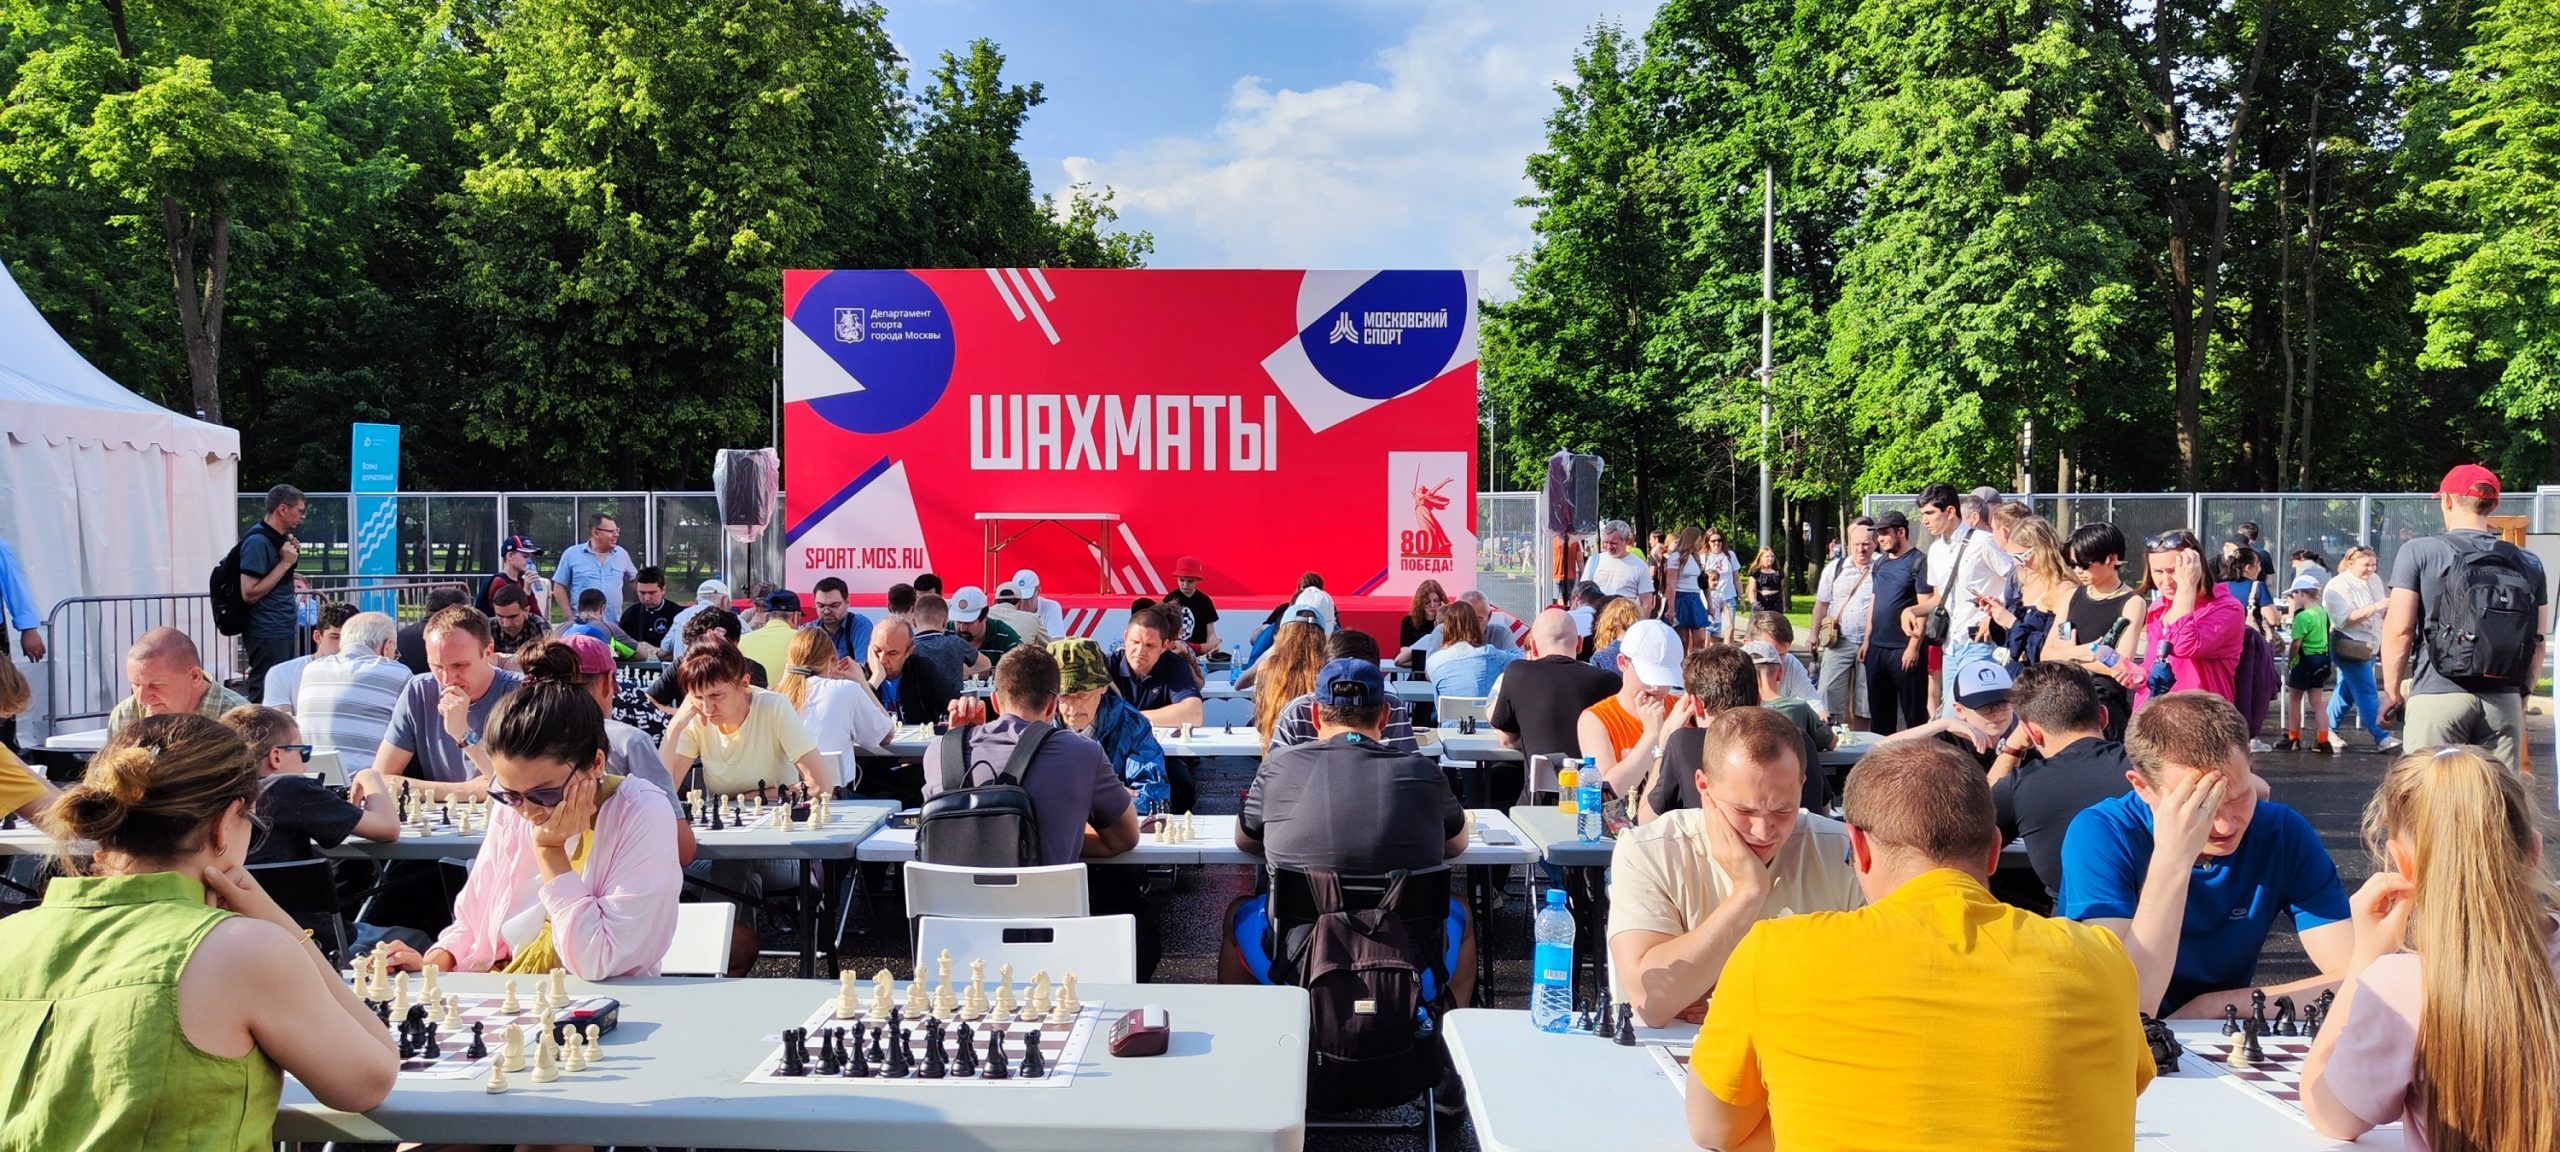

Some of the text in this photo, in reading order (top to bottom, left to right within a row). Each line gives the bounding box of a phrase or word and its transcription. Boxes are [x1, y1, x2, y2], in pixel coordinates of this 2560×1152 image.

[870, 309, 932, 320] Департамент
[1363, 308, 1448, 328] МОСКОВСКИЙ
[870, 321, 903, 331] спорта
[870, 331, 942, 342] города Москвы
[1363, 328, 1404, 345] СПОРТ
[970, 394, 1277, 471] ШАХМАТЫ
[1401, 529, 1429, 554] 80
[805, 547, 924, 570] SPORT.MOS.RU
[1400, 558, 1454, 573] ПОБЕДА!
